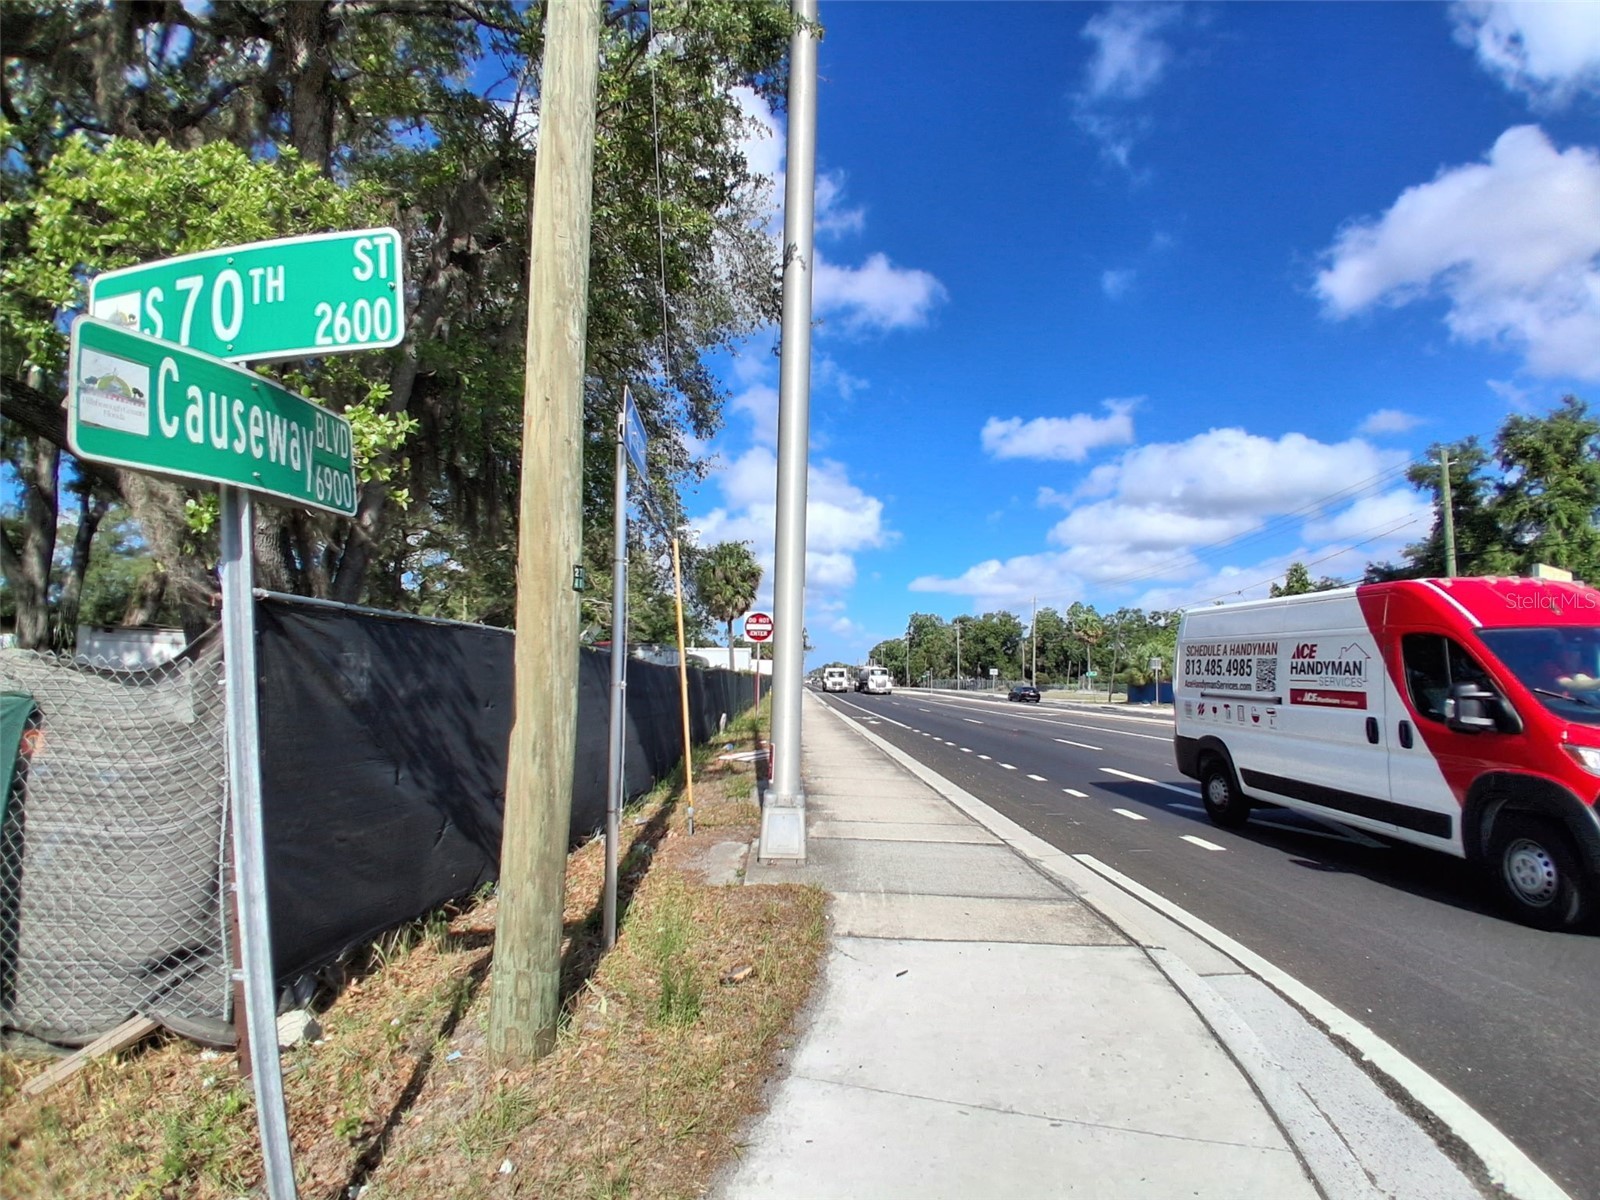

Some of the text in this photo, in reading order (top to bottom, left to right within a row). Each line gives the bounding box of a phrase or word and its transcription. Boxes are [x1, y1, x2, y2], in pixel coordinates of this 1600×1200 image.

[144, 237, 392, 346] S 70TH ST
[314, 298, 392, 346] 2600
[157, 357, 349, 493] Causeway BLVD
[315, 465, 352, 508] 6900
[1186, 642, 1278, 657] SCHEDULE A HANDYMAN
[1291, 642, 1318, 659] ACE
[1185, 658, 1253, 677] 813.485.4985
[1290, 660, 1363, 676] HANDYMAN
[1318, 676, 1363, 688] SERVICES
[1302, 692, 1318, 703] ACE
